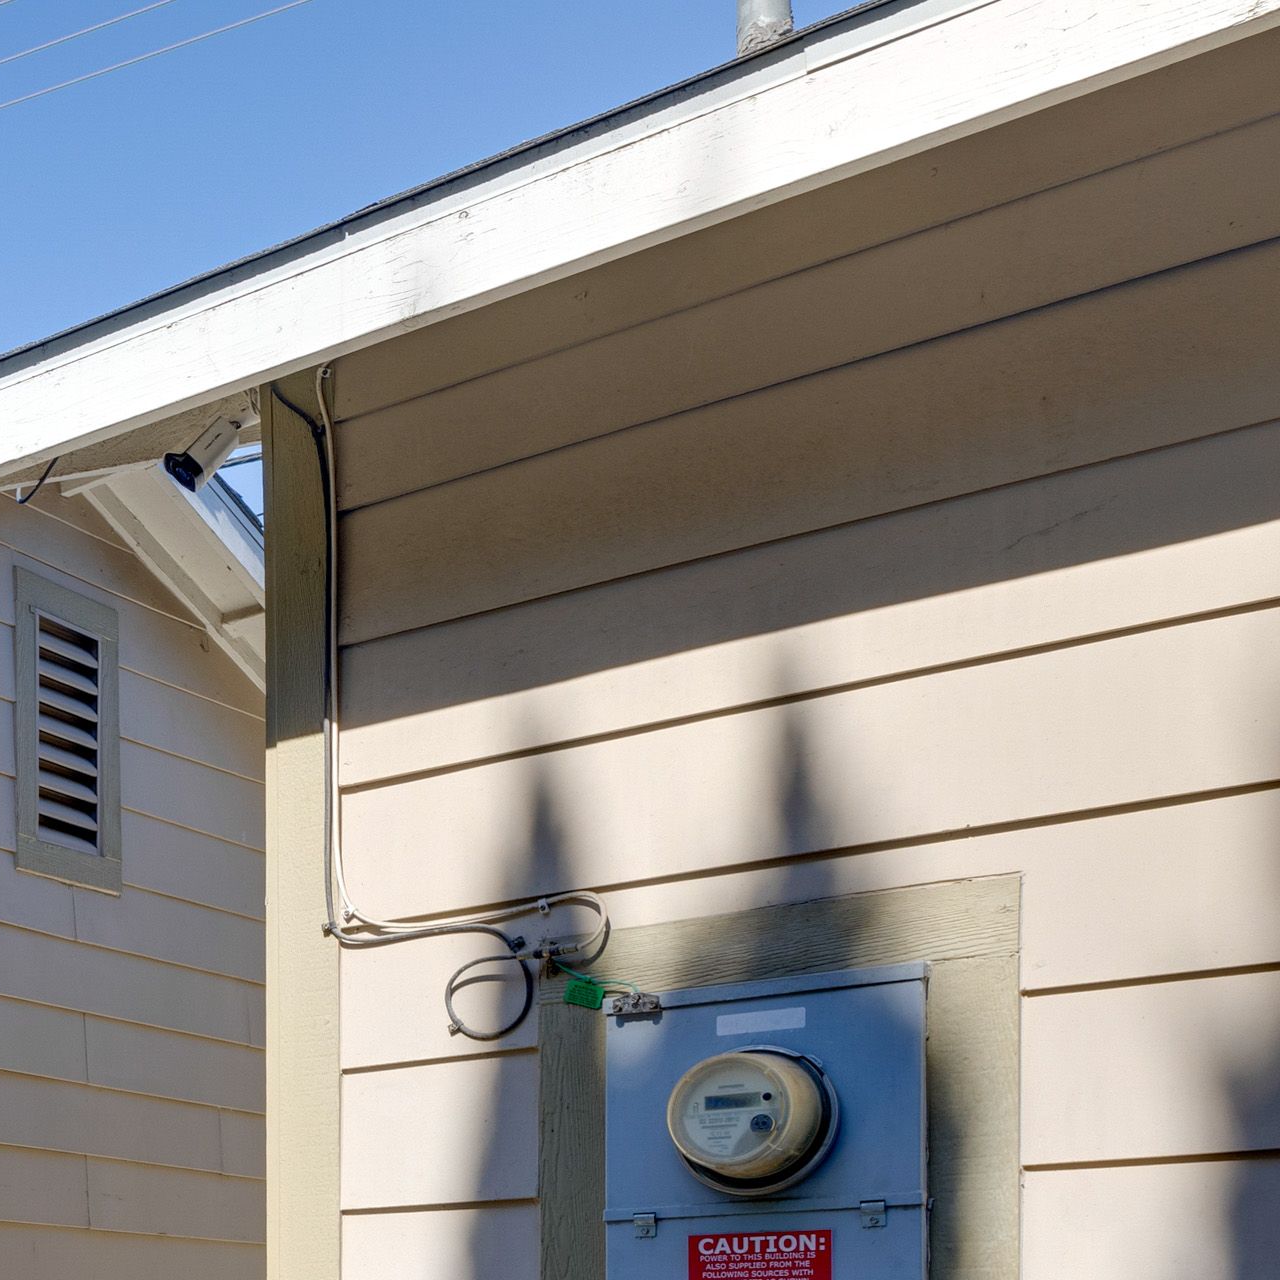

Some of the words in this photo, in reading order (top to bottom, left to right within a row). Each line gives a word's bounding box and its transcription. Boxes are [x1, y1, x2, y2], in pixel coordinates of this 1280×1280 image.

[698, 1234, 826, 1254] CAUTION:
[765, 1252, 805, 1260] BUILDING
[702, 1271, 748, 1279] FOLLOWING
